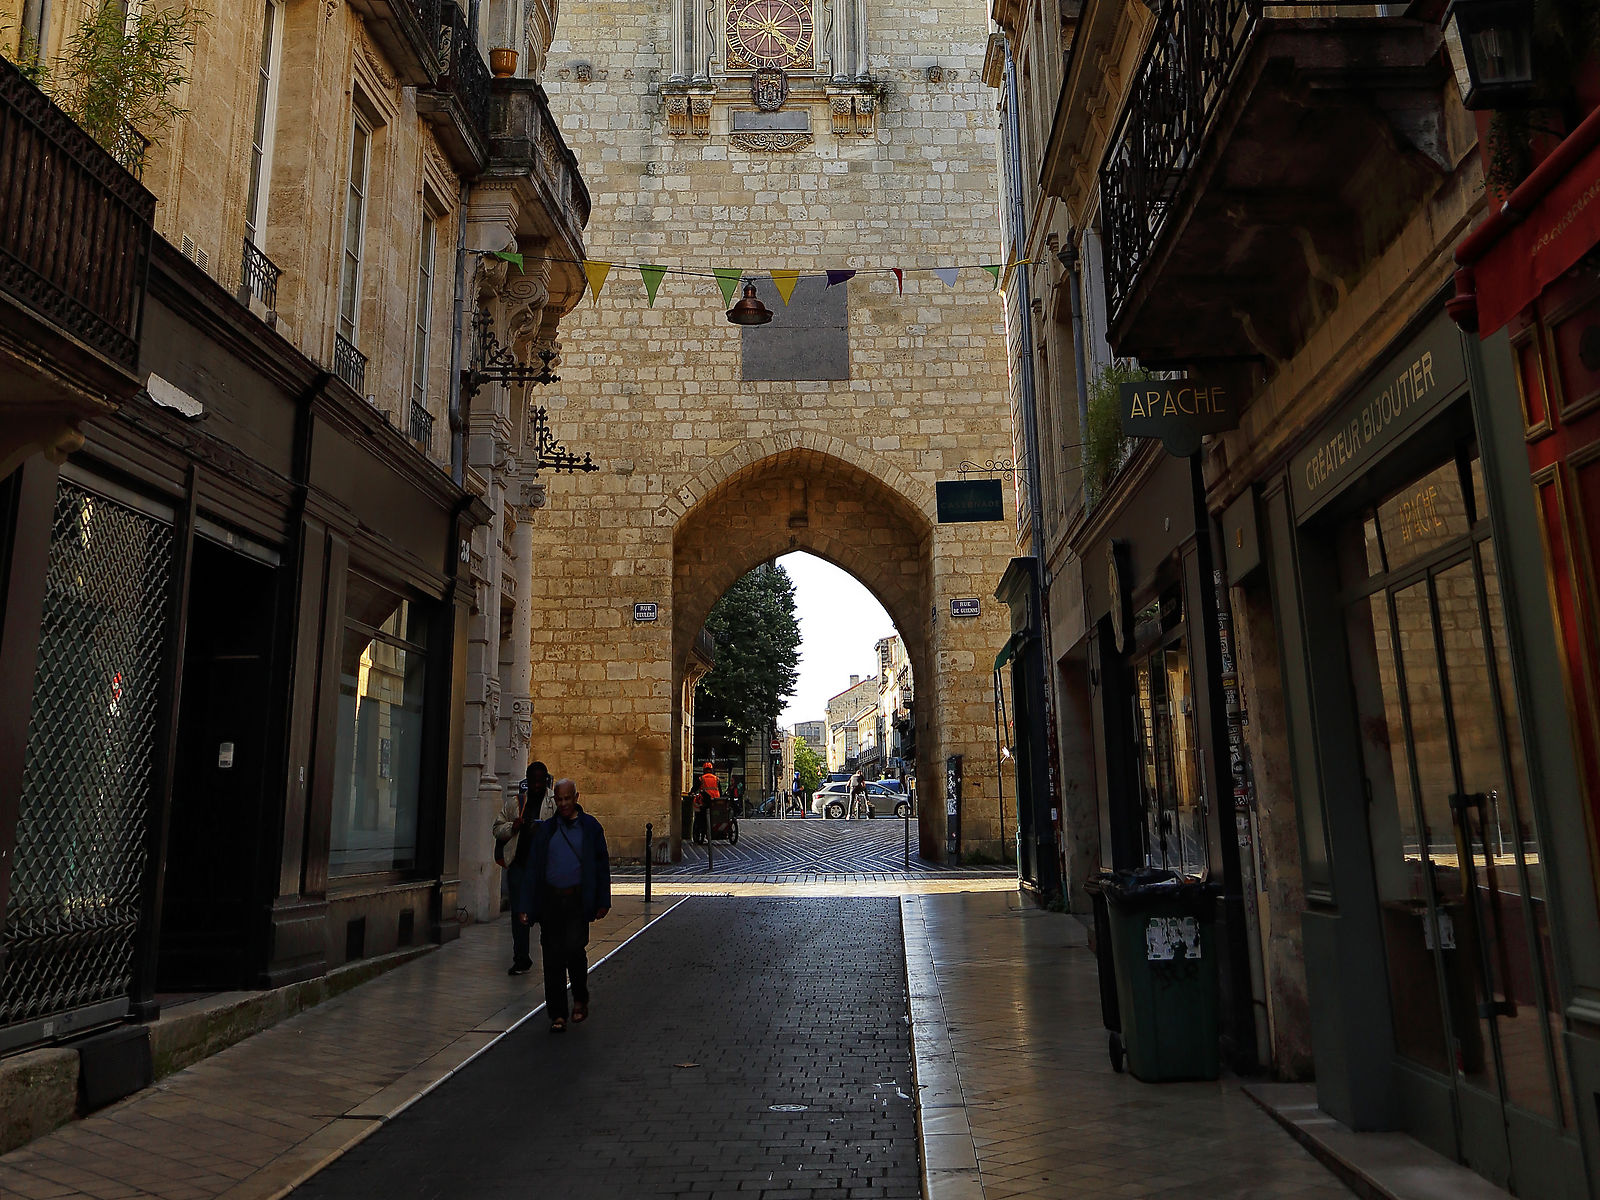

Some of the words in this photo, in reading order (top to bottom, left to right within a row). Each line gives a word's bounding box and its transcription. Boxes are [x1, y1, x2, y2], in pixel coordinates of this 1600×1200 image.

[1130, 386, 1226, 419] APACHE
[1305, 418, 1361, 491] CRÉATEUR
[1361, 351, 1436, 443] BIJOUTIER
[1400, 485, 1442, 545] APACHE
